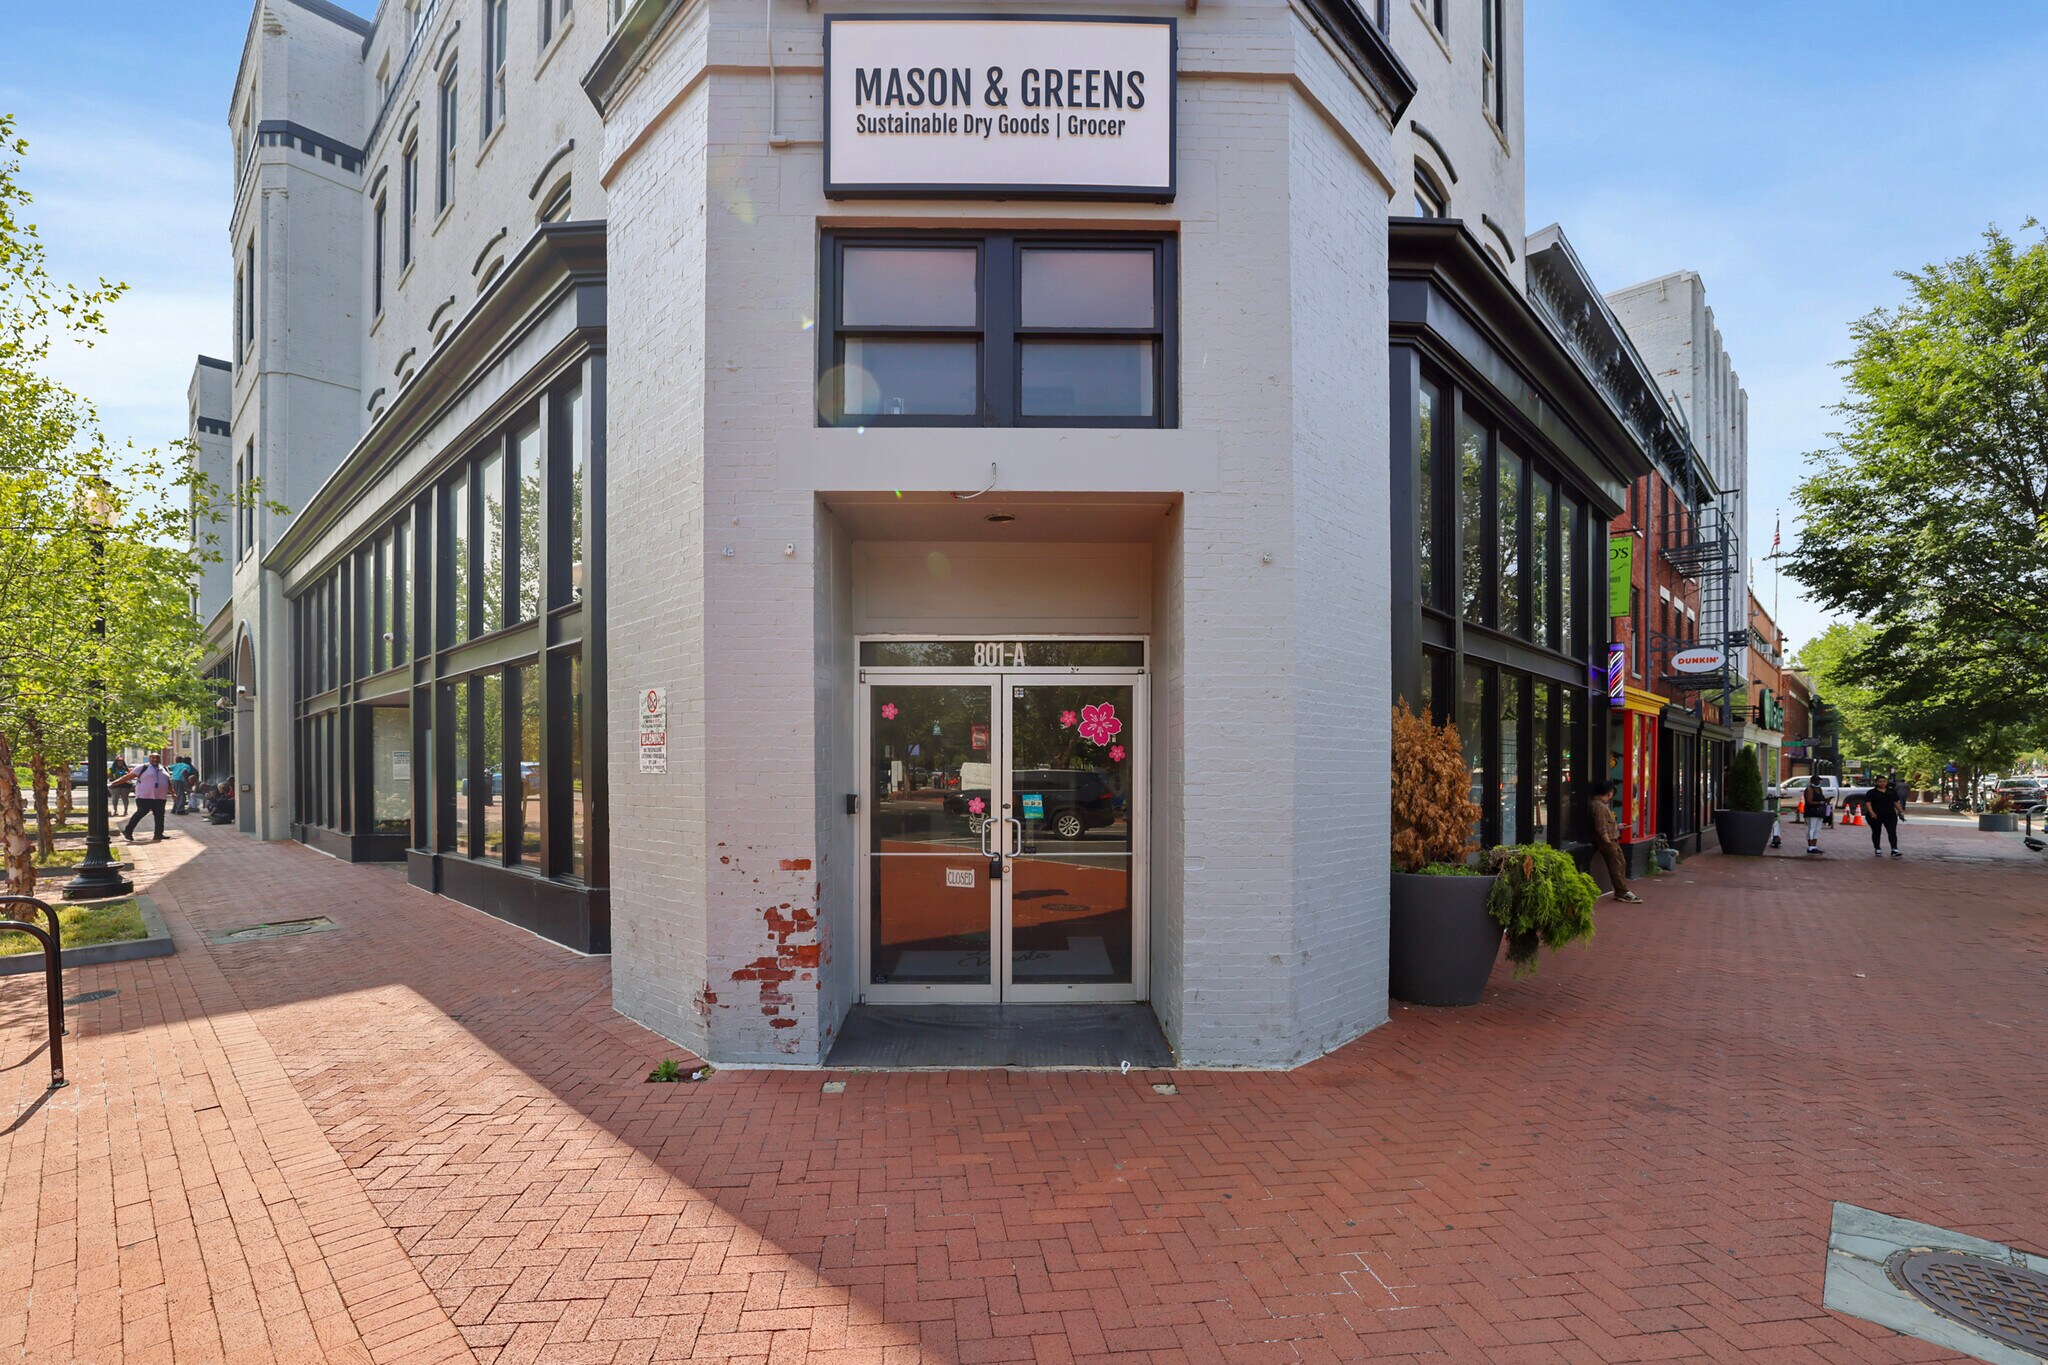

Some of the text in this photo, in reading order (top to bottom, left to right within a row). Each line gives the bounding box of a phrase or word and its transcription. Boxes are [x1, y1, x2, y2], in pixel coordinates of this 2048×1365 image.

[855, 66, 1145, 110] MASON & GREENS
[856, 111, 957, 135] Sustainable
[963, 113, 992, 138] Dry
[998, 113, 1049, 135] Goods
[1068, 115, 1126, 136] Grocer
[973, 642, 1026, 666] 801-A
[1678, 656, 1719, 665] DUNKIN'
[948, 871, 973, 885] CLOSED
